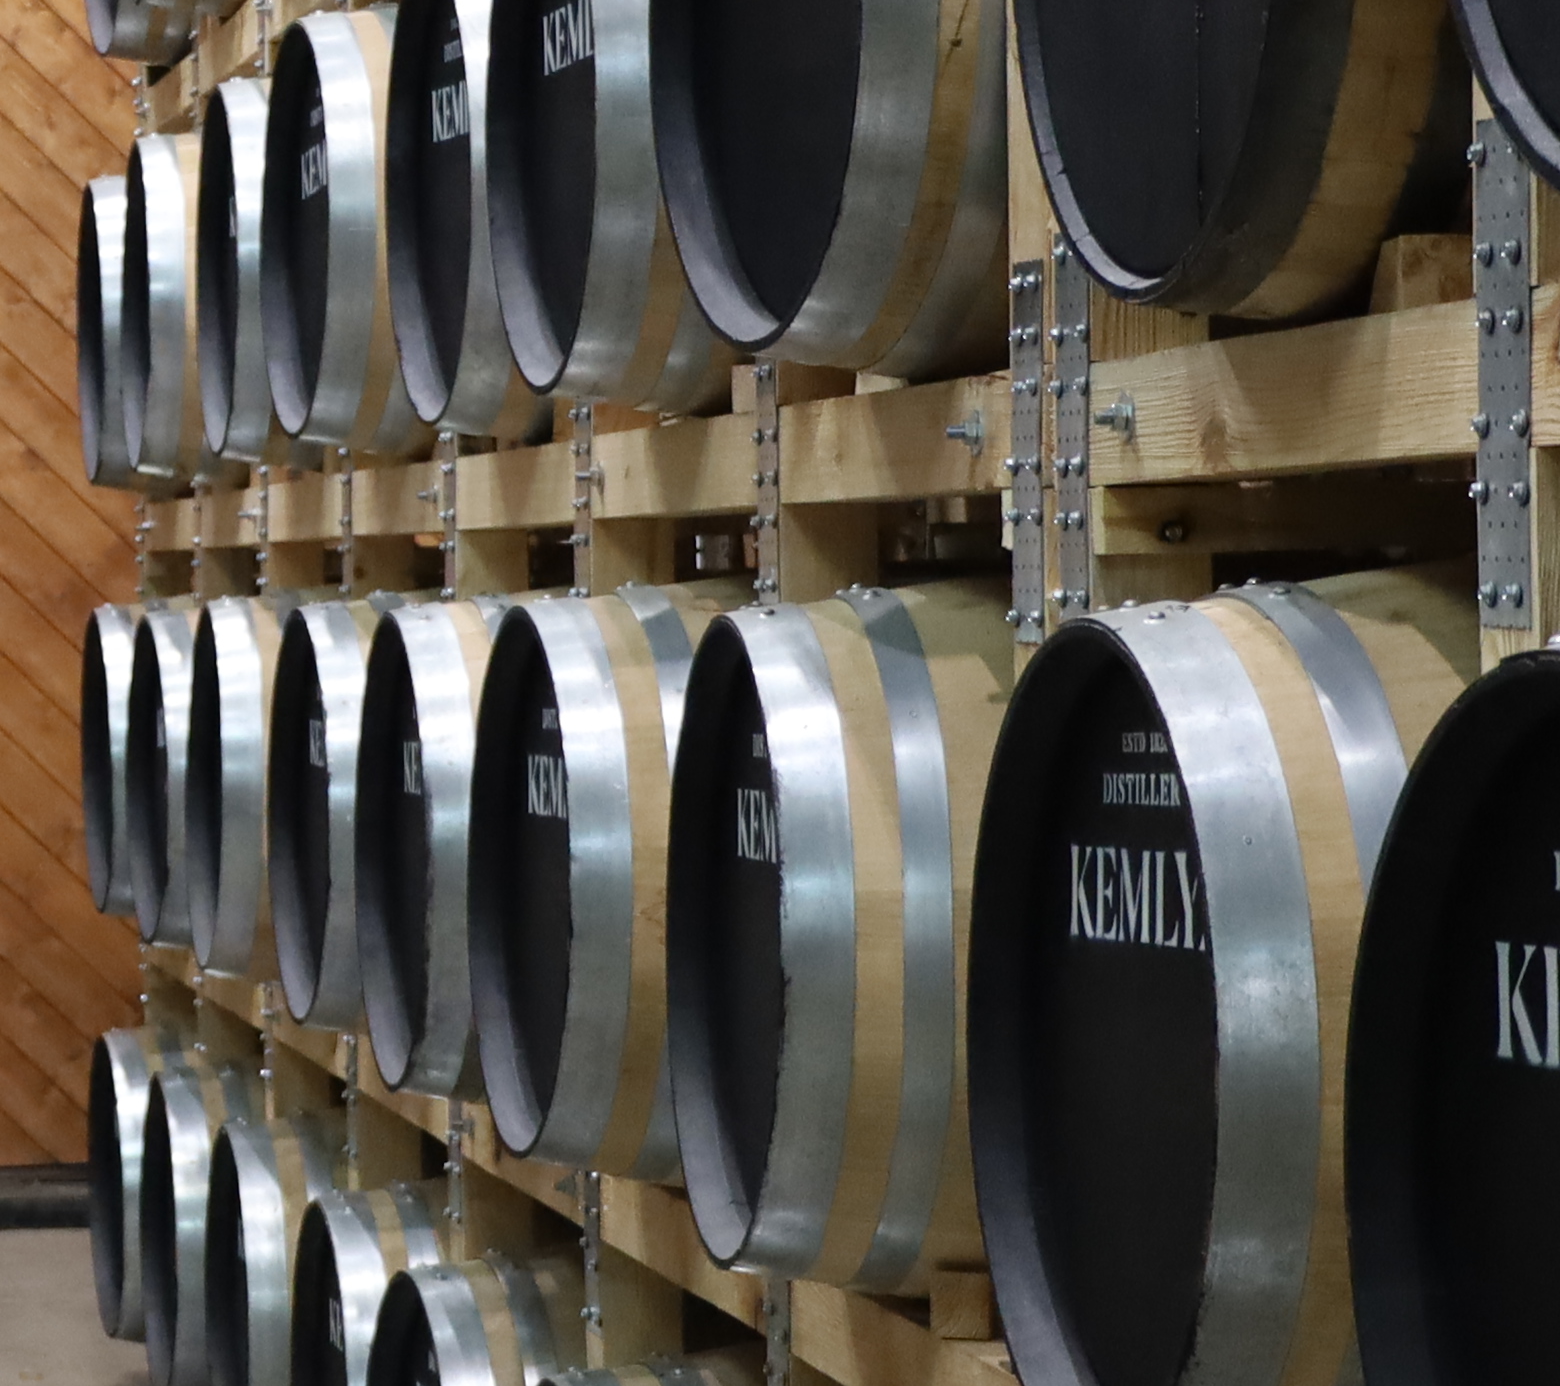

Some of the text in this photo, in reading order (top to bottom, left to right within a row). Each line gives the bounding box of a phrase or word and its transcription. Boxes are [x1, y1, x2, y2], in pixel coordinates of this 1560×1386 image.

[528, 754, 567, 819] KEM
[1102, 773, 1181, 807] DISTILLER
[737, 788, 778, 864] KEM
[1070, 843, 1207, 952] KEMLY
